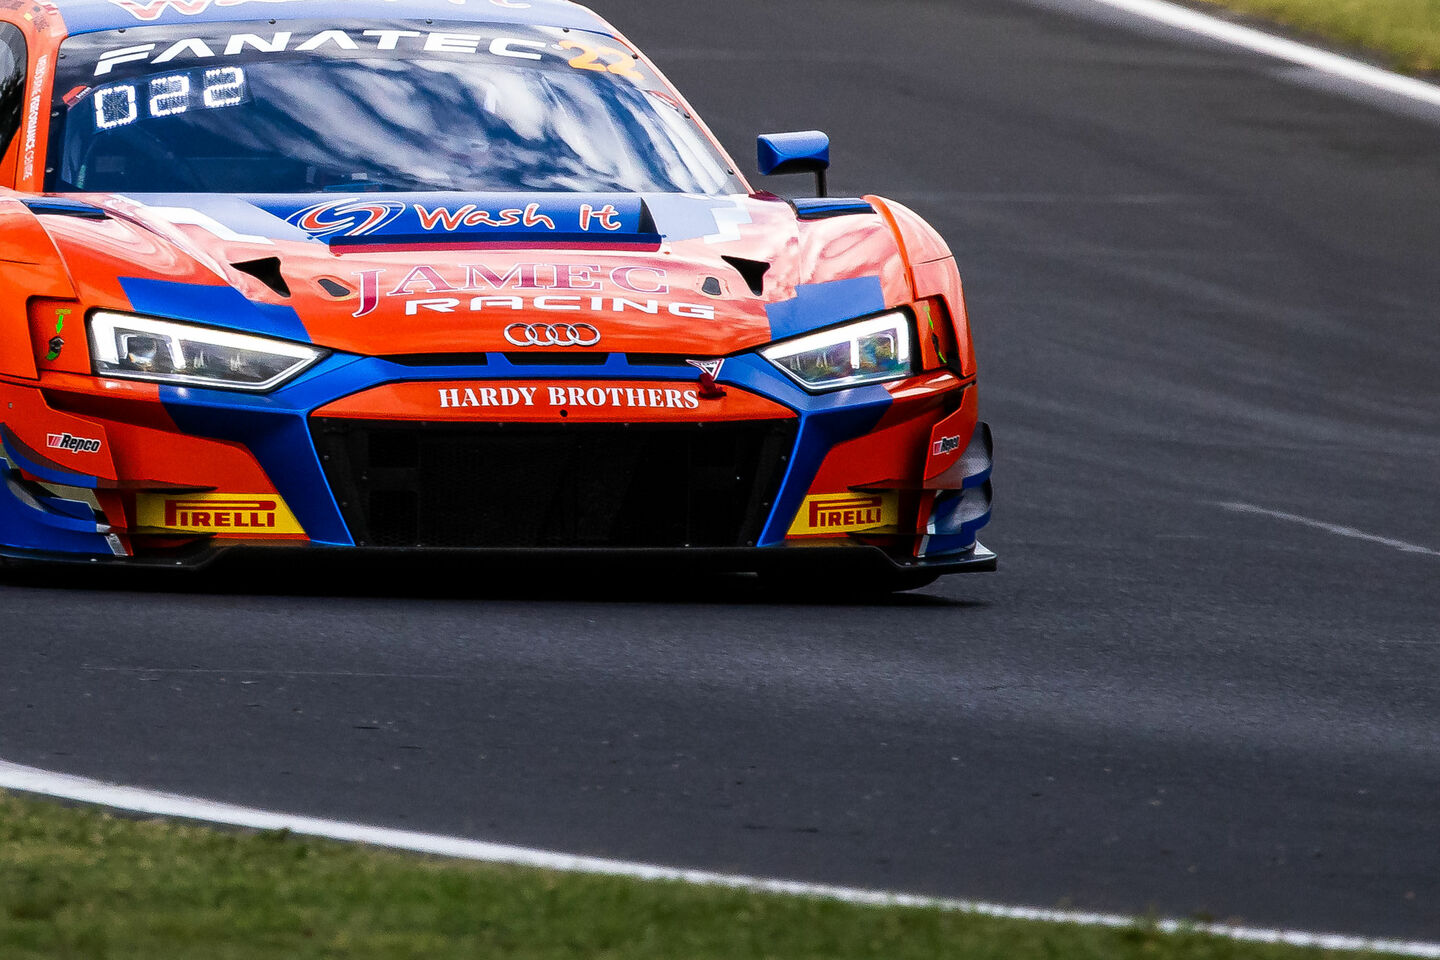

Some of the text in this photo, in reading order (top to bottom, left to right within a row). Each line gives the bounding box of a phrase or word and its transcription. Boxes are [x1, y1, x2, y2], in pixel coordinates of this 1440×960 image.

[93, 29, 548, 77] FANATEC
[558, 40, 645, 81] 22
[93, 66, 245, 131] 022
[413, 202, 622, 231] Wash It
[351, 262, 670, 319] JAMEC
[404, 295, 715, 320] RACING
[438, 386, 700, 409] HARDY BROTHERS
[59, 433, 101, 453] Repco
[164, 499, 277, 528] PIRELLI
[808, 496, 882, 528] PIRELLI
